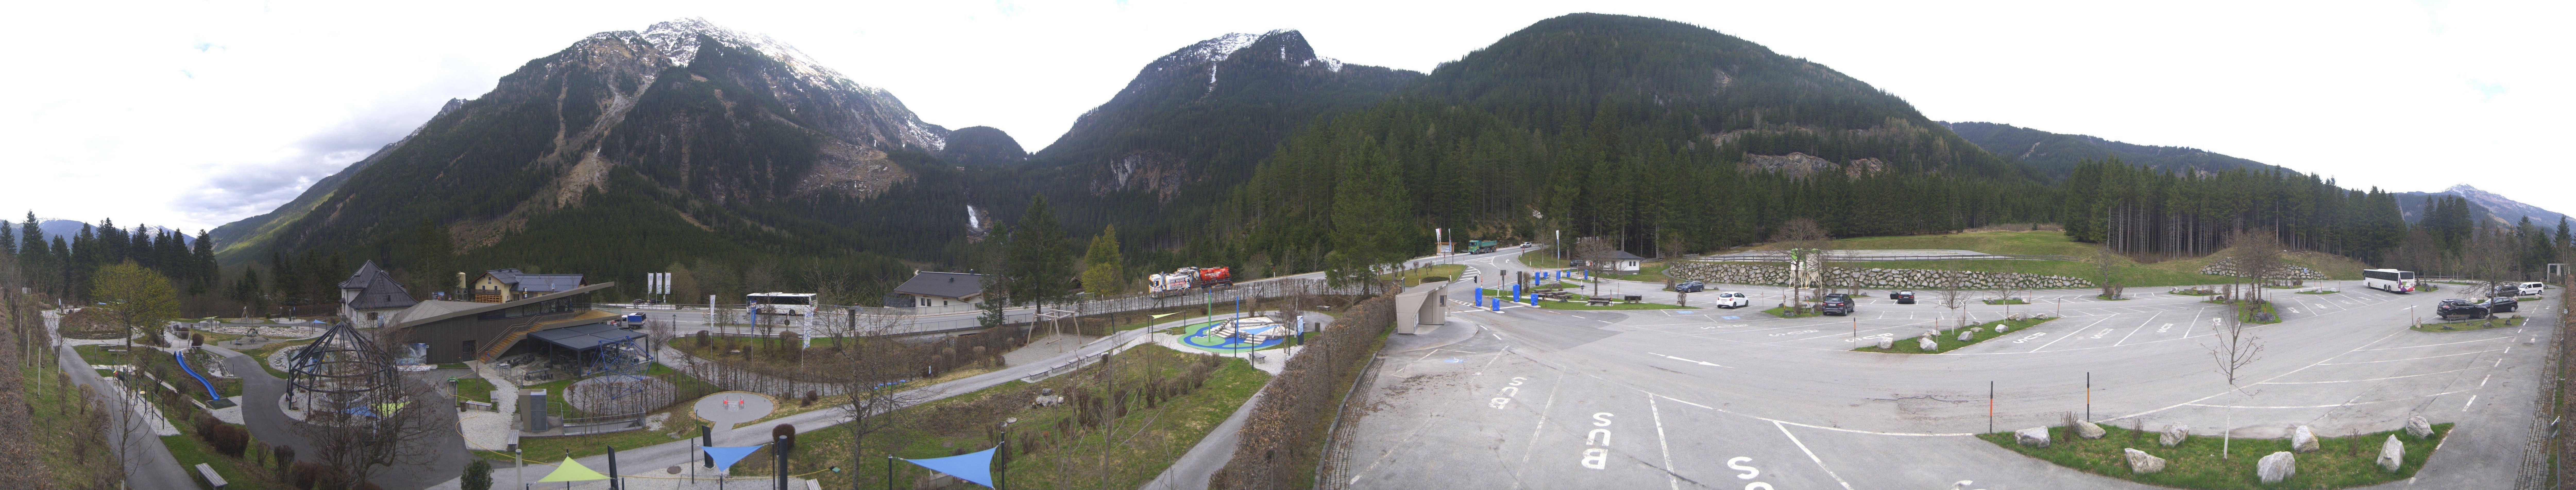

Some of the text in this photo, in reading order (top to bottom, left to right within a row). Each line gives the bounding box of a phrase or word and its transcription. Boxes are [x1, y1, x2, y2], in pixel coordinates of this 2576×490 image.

[2156, 323, 2174, 332] BUS
[1845, 333, 1894, 342] BUS
[2012, 332, 2046, 344] BUS
[1488, 377, 1527, 409] BUS
[1581, 412, 1614, 469] BUS
